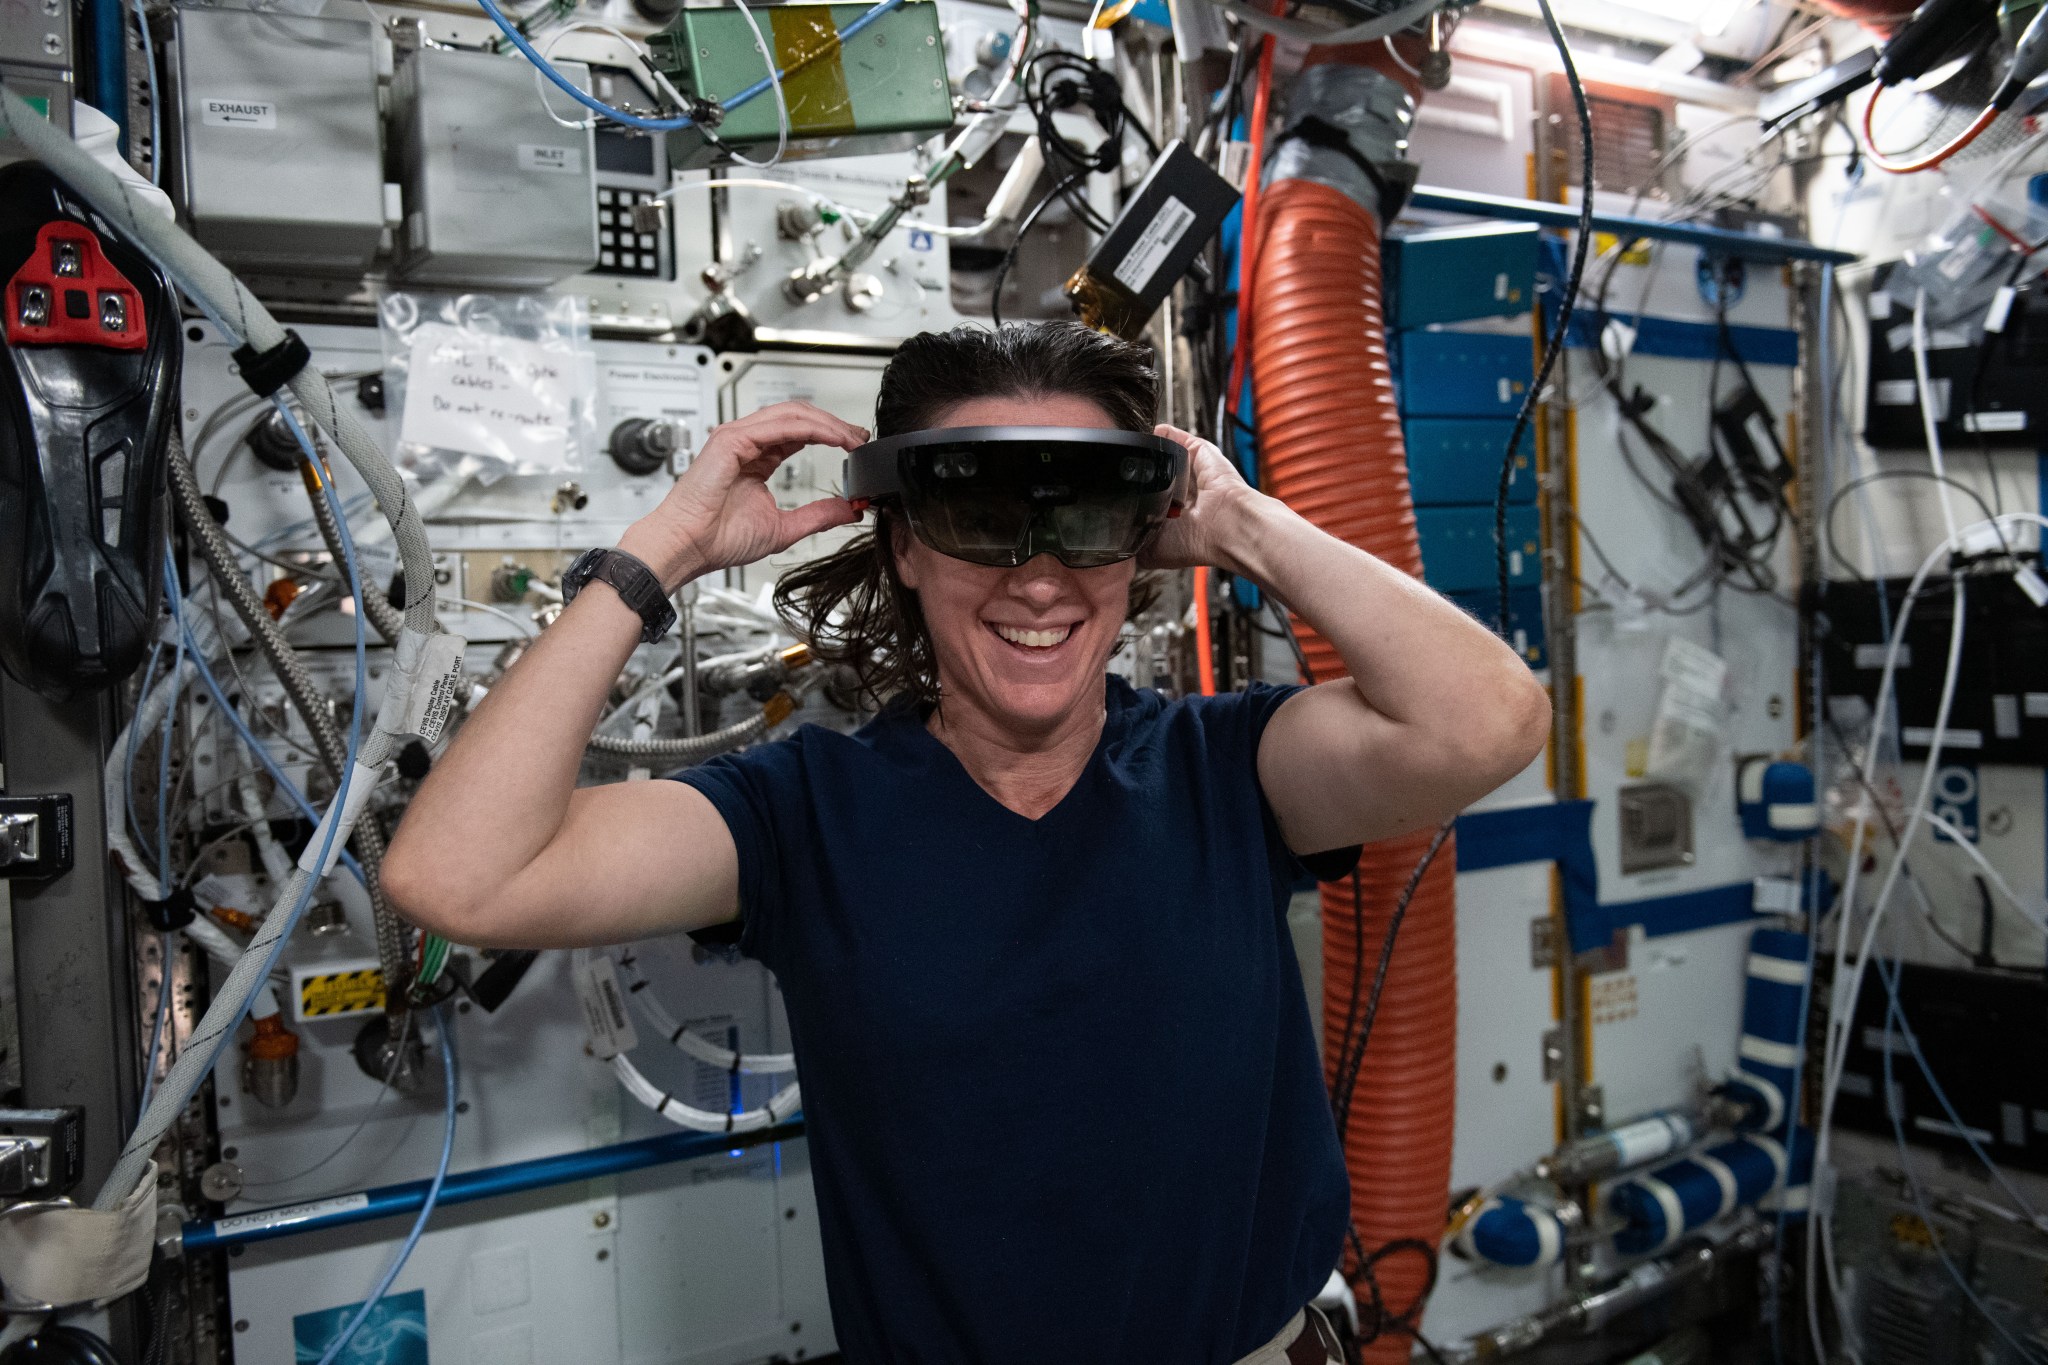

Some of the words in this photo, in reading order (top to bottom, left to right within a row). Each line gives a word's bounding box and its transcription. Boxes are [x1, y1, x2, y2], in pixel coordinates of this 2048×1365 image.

[209, 102, 268, 115] EXHAUST
[534, 149, 564, 159] INLET
[451, 374, 495, 390] cables
[432, 394, 451, 411] Do
[457, 403, 485, 414] not
[430, 679, 441, 696] Cable
[425, 696, 437, 717] Display
[428, 710, 439, 728] CEVIS
[434, 690, 445, 710] Control
[440, 673, 450, 690] Panel
[431, 721, 442, 742] CEVIS
[438, 695, 451, 721] DISPLAY
[446, 674, 458, 695] CABLE
[452, 655, 462, 673] PORT
[419, 715, 430, 735] CEVIS
[221, 1217, 243, 1229] DO
[246, 1212, 274, 1223] NOT
[280, 1205, 321, 1217] MOVE
